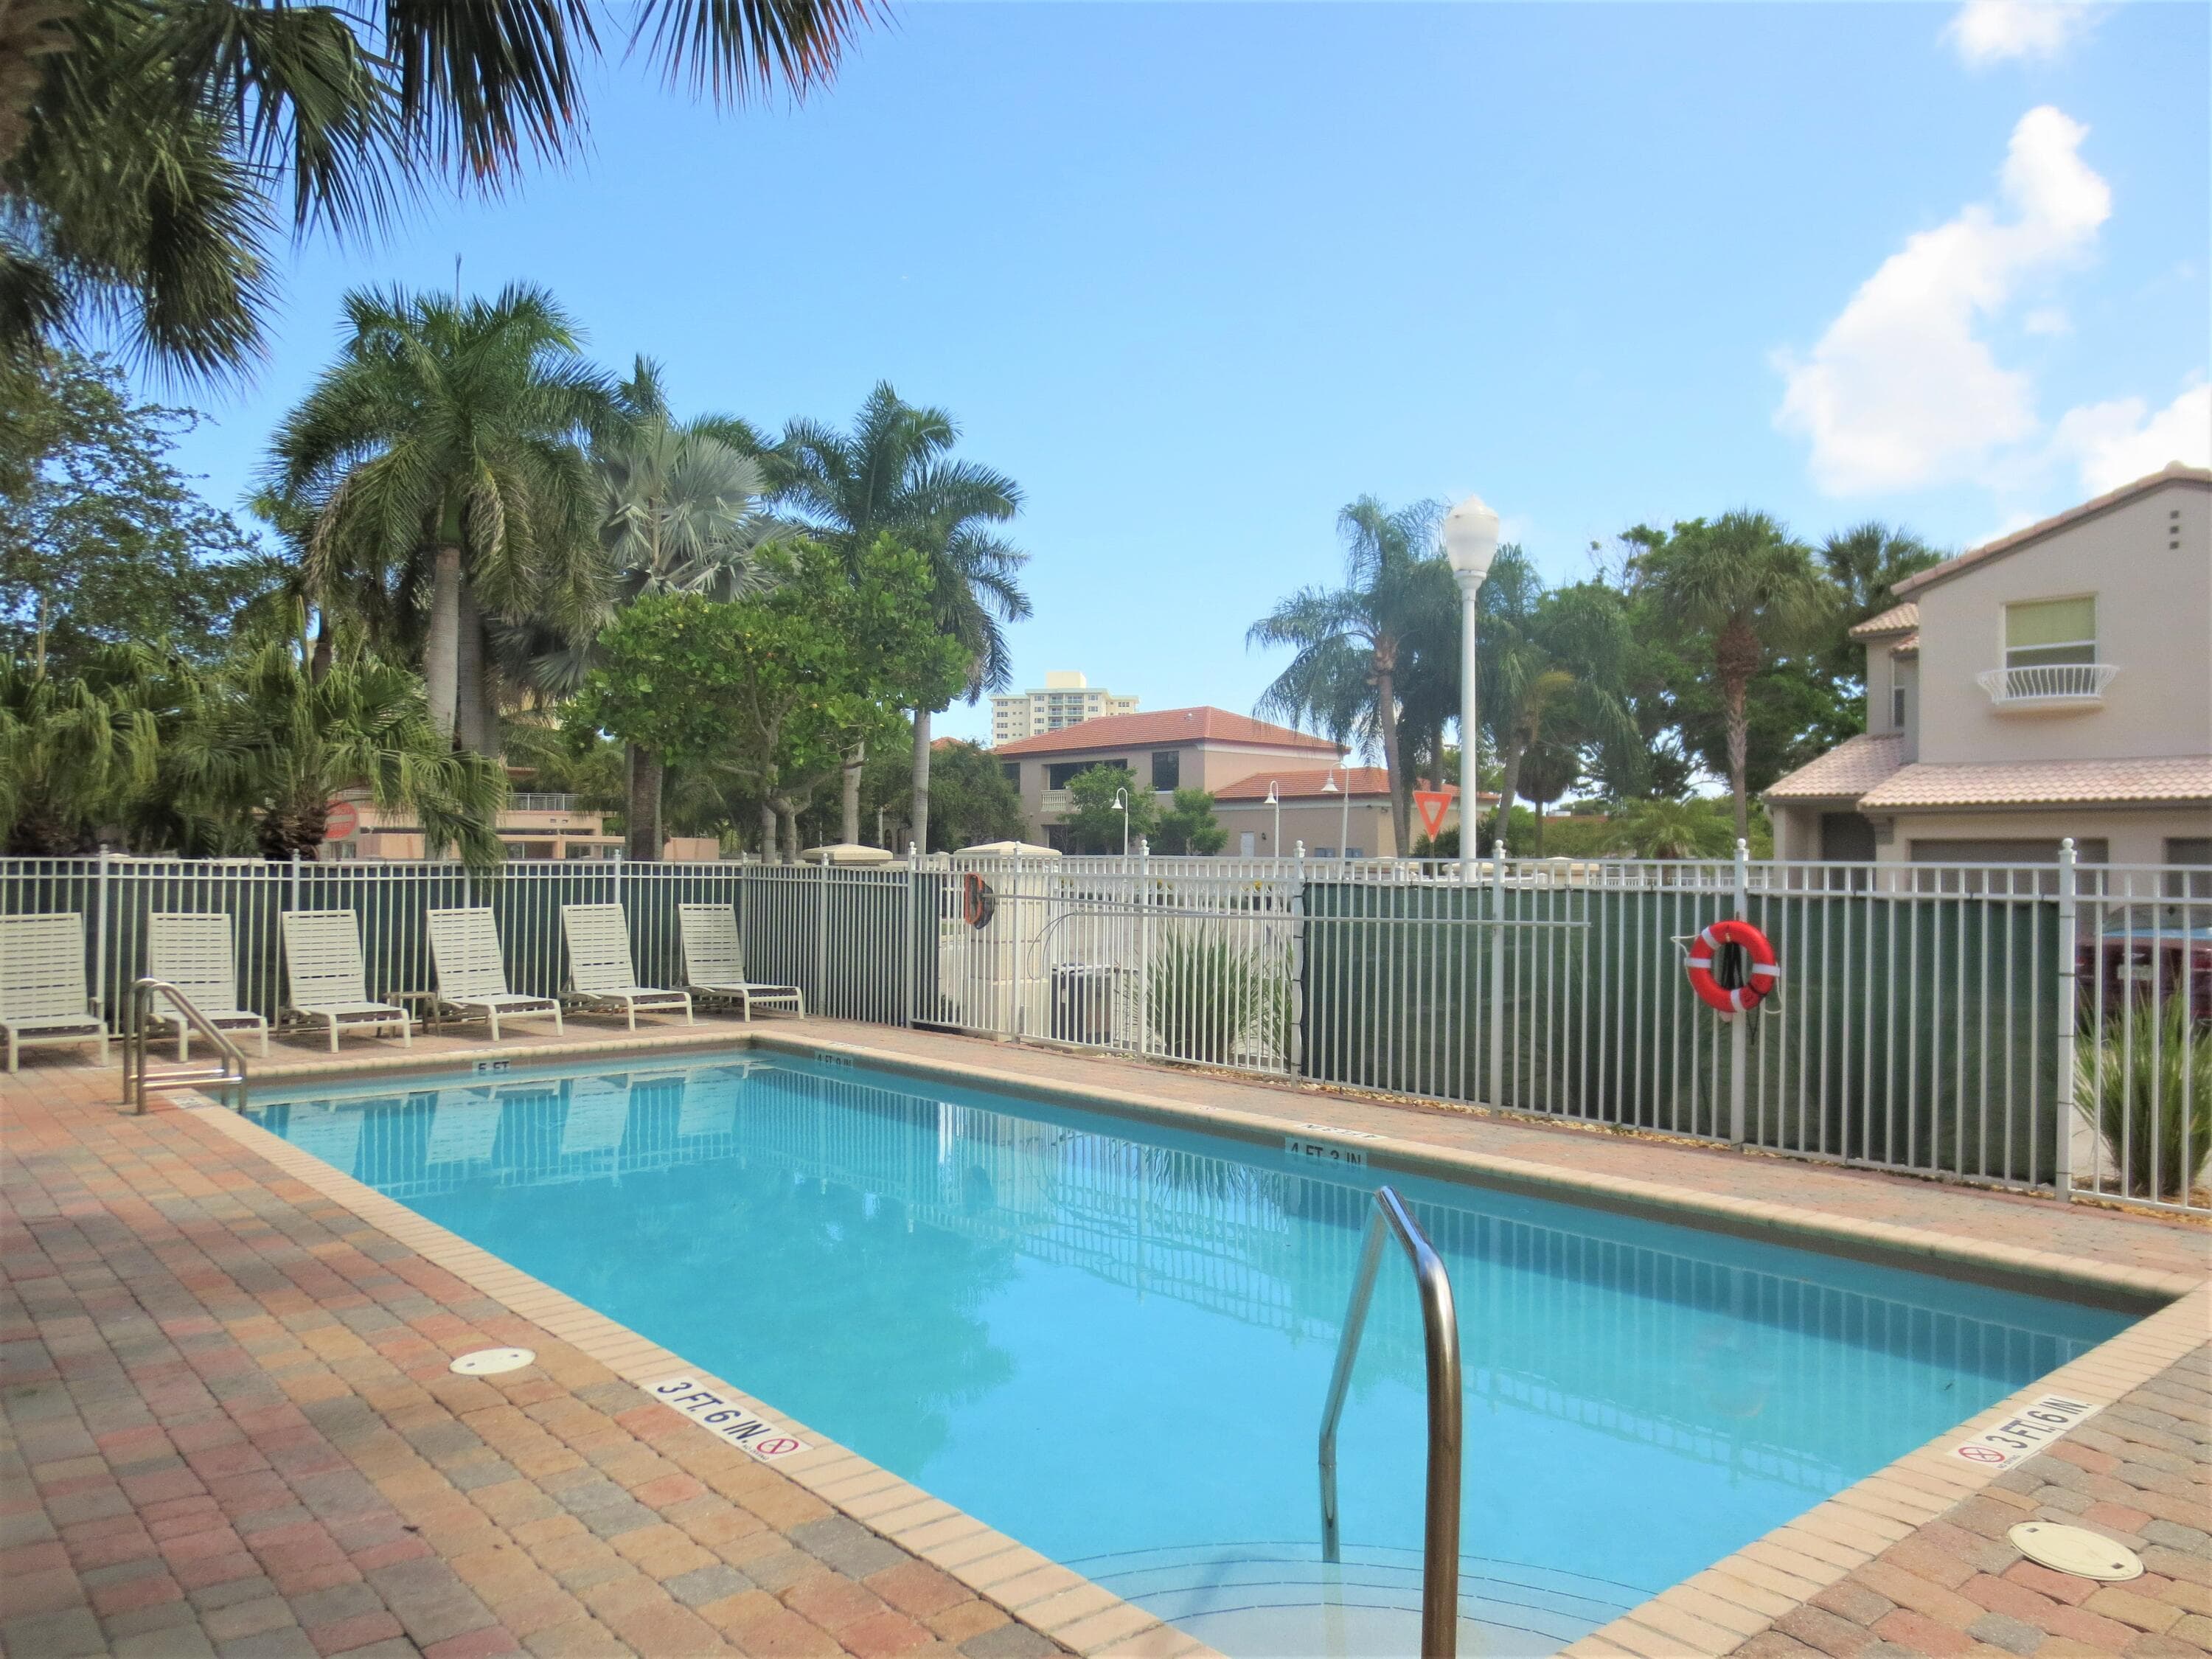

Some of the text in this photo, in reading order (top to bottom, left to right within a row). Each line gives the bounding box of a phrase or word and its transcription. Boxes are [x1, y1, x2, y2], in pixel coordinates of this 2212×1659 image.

[1306, 1144, 1324, 1158] FT
[1346, 1152, 1361, 1164] IN
[657, 1382, 771, 1443] 3 FT. 6 IN.
[1985, 1397, 2093, 1449] 3 FT. 6 IN.
